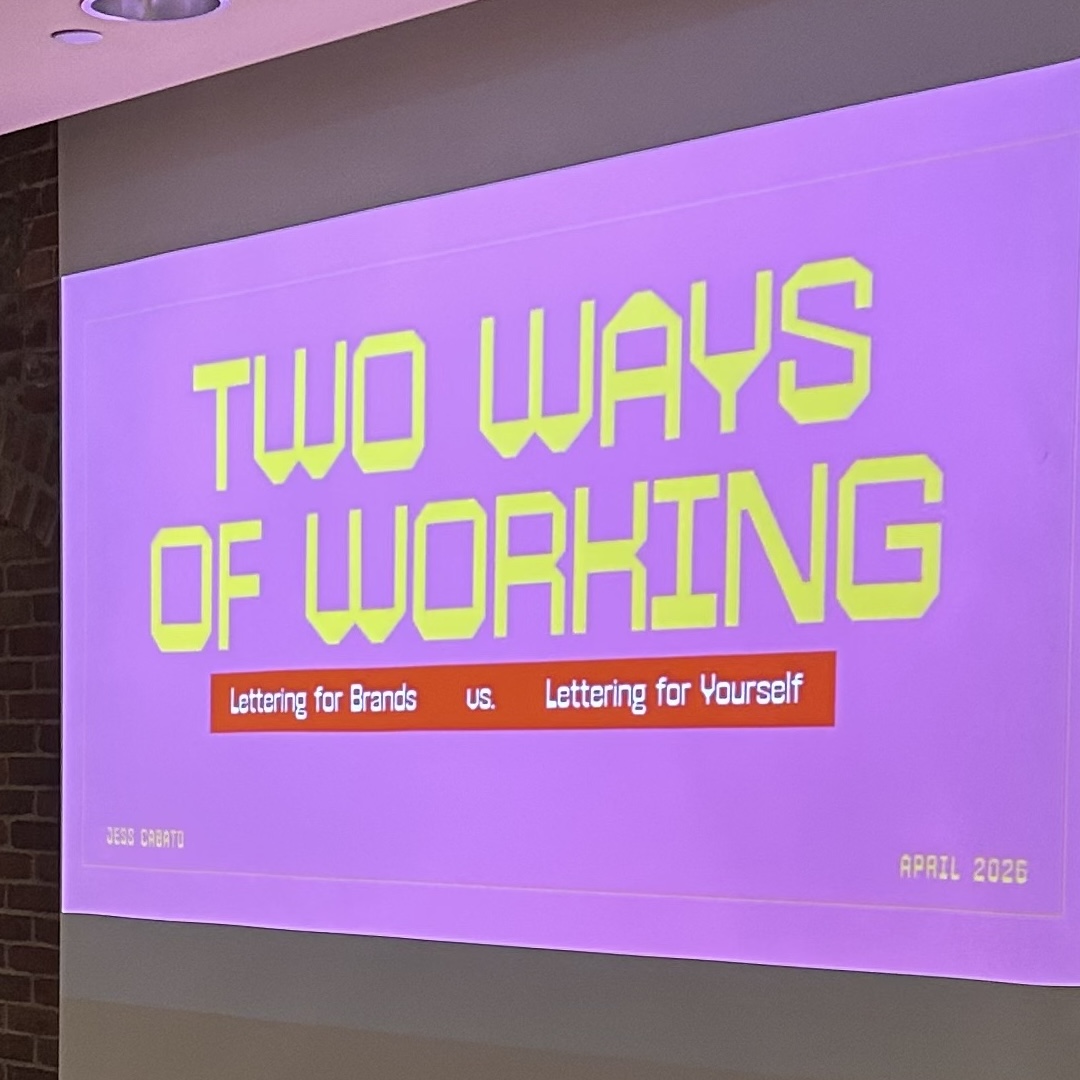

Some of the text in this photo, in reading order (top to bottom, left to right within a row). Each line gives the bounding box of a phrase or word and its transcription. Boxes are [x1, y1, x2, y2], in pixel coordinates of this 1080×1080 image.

[194, 258, 871, 489] TWO WAYS
[152, 455, 941, 651] OF WORKING
[230, 687, 308, 720] Lettering
[314, 685, 344, 713] for
[350, 683, 417, 713] Brands
[545, 678, 647, 715] Lettering
[655, 676, 692, 707] for
[700, 671, 804, 706] Yourself
[106, 826, 135, 847] JESS
[899, 853, 1028, 884] APRIL 2026
